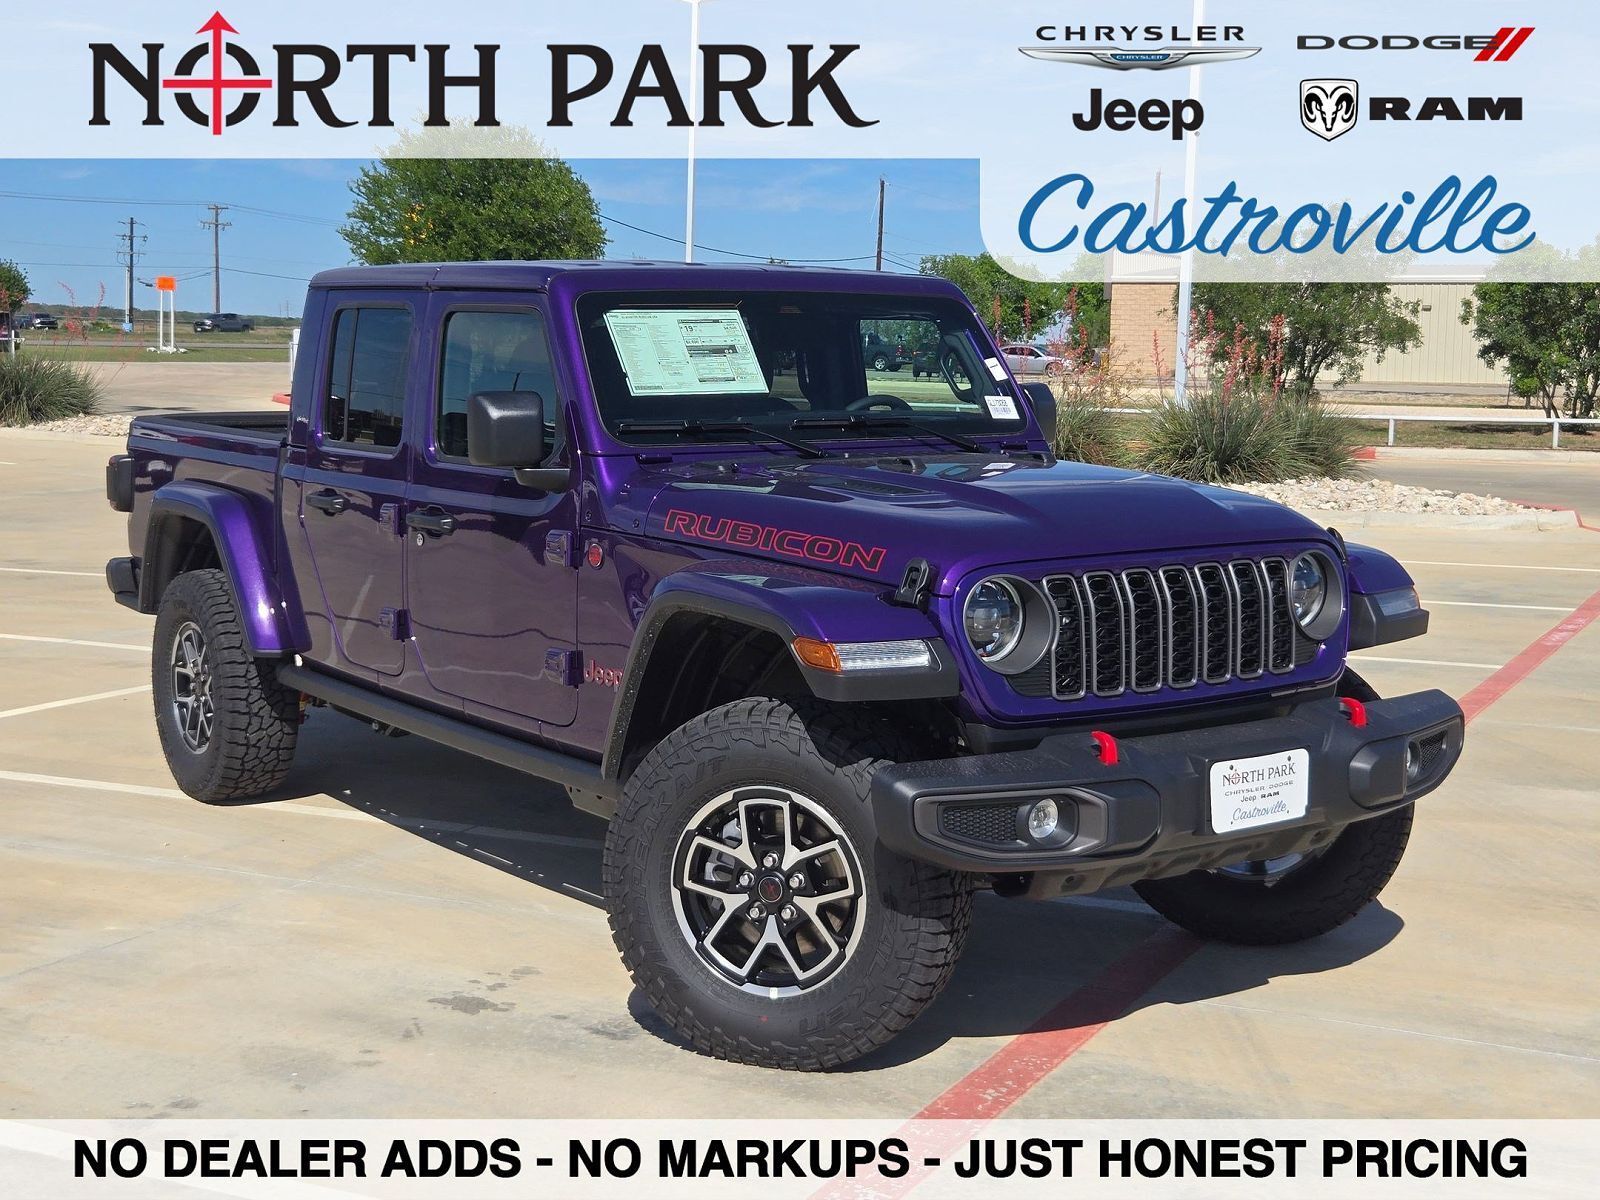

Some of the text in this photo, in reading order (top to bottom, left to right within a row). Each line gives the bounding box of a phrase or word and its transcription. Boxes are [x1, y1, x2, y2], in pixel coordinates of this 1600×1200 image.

[664, 509, 887, 572] RUBICON
[583, 659, 623, 692] Jeep
[1223, 762, 1296, 787] NORTH PARK
[1225, 780, 1294, 796] CHRYSLER DODGE
[1261, 791, 1280, 799] RAM
[1233, 800, 1287, 821] Castroville
